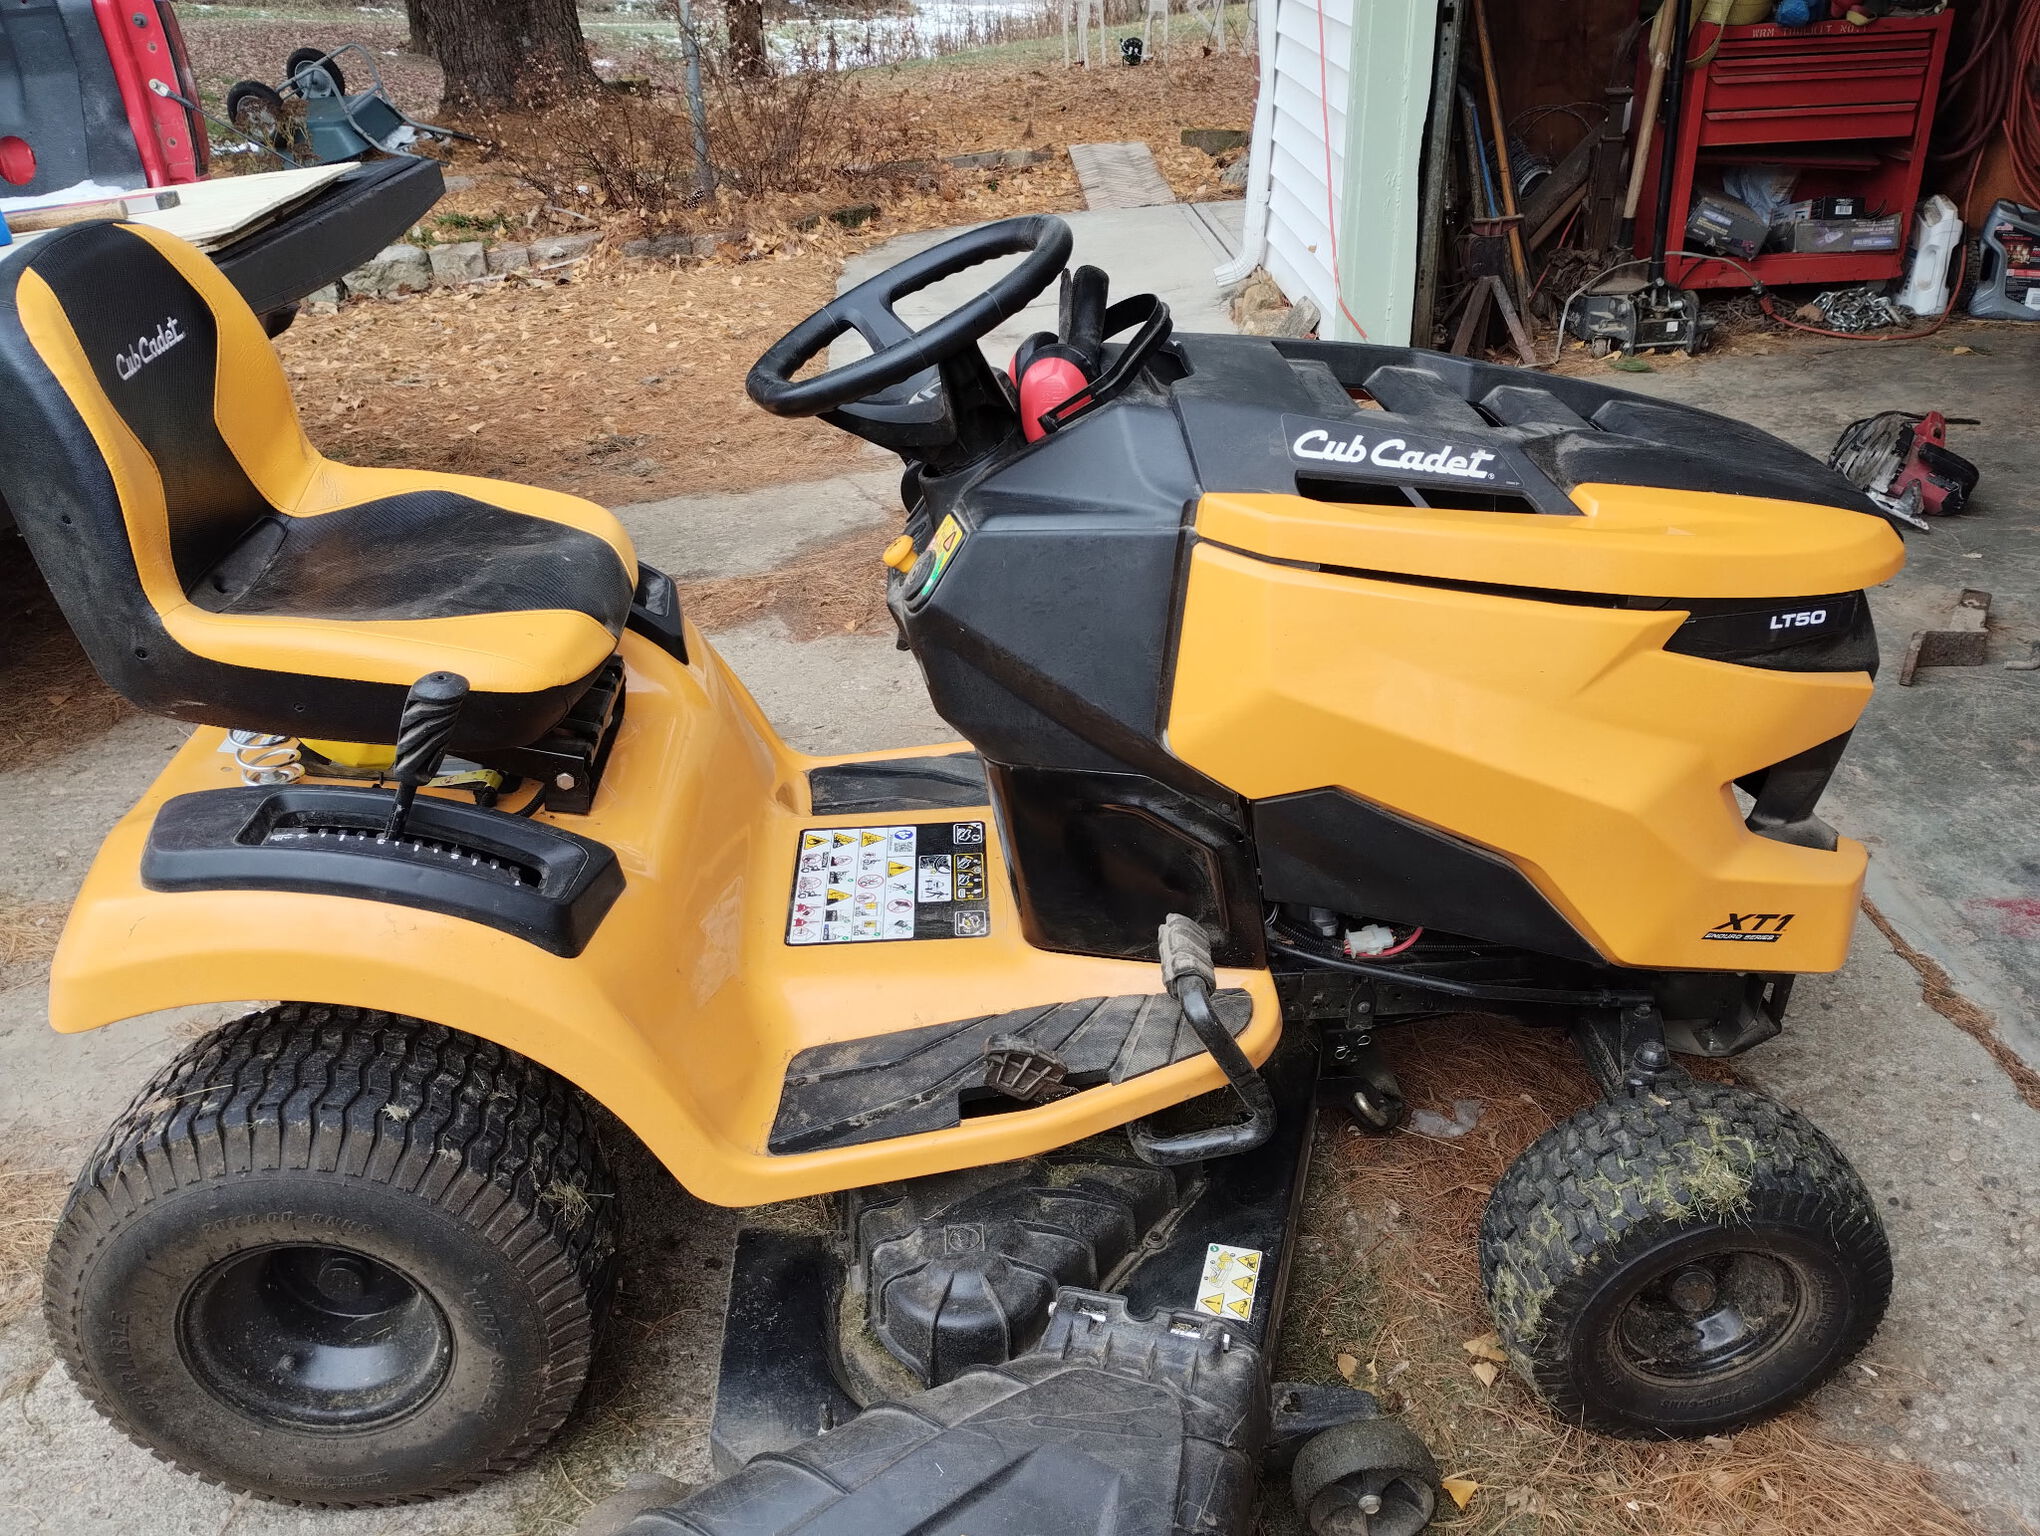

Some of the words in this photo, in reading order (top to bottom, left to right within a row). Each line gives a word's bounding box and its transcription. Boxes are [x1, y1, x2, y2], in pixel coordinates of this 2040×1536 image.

[116, 343, 142, 381] Cub
[138, 316, 186, 364] Cadet
[1293, 429, 1367, 463] Cub
[1371, 438, 1496, 480] Cadet
[1769, 609, 1827, 630] LT50
[1711, 913, 1796, 932] XT1
[1704, 932, 1743, 940] ENDURO
